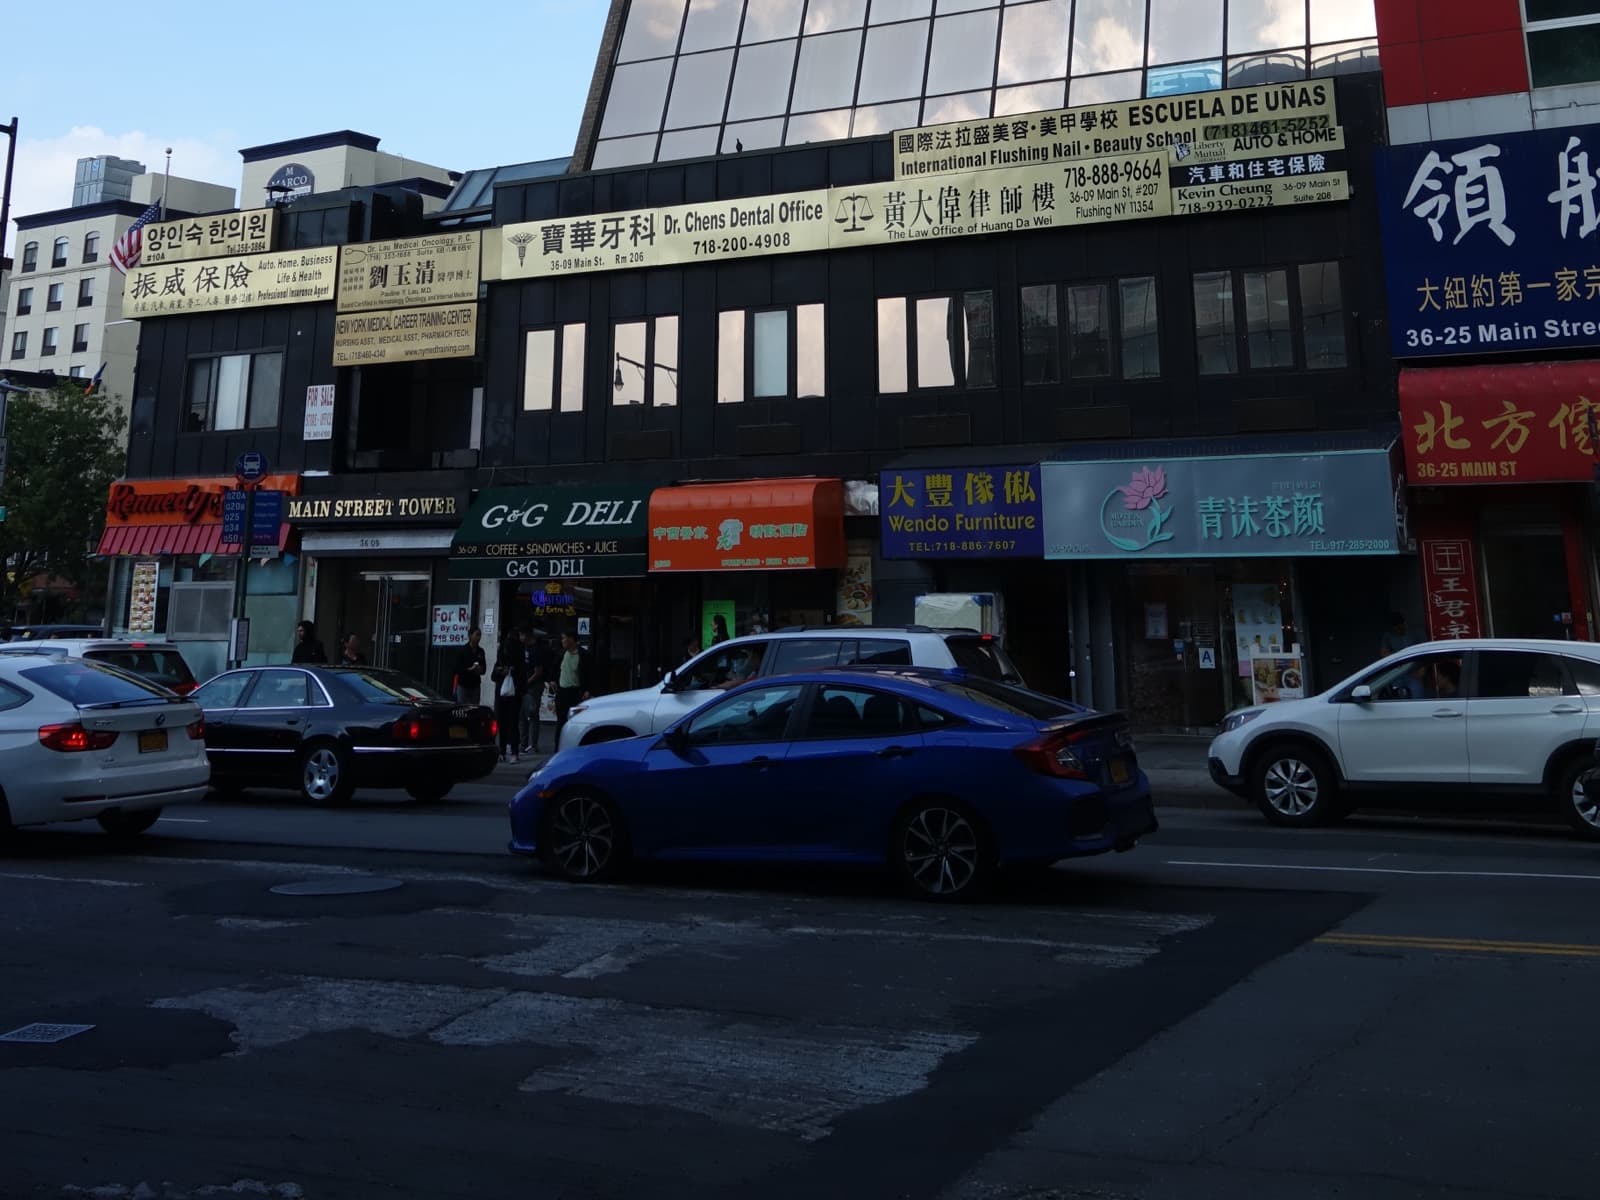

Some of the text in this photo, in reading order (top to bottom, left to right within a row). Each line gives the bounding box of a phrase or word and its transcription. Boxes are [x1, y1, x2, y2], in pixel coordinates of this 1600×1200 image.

[1129, 85, 1326, 127] ESCUELA DE UÑAS
[1194, 141, 1225, 150] Liberty
[1233, 128, 1337, 151] AUTO & HOME
[901, 128, 1196, 176] International Flushing Nail Beauty School
[1194, 148, 1226, 158] Mutual
[1063, 157, 1162, 189] 718-888-9664
[1188, 154, 1326, 184] 汽車和住宅保險
[1069, 189, 1095, 203] 36-09
[1097, 188, 1120, 201] Main
[1135, 183, 1159, 195] #207
[1177, 182, 1273, 200] Kevin Cheung
[1282, 181, 1307, 191] 36-09
[1309, 179, 1331, 189] Main
[883, 181, 1056, 230] 黃大偉律師樓
[1179, 196, 1274, 214] 718-939-0222
[1293, 193, 1314, 202] Suite
[664, 200, 823, 235] Dr. Chens Dental Office
[1075, 200, 1154, 219] Flushing NY 11354
[148, 214, 267, 251] 양인숙 한의원
[541, 213, 656, 256] 寶華牙科
[888, 215, 1052, 240] The Law Office of Huang Da Wei
[393, 240, 419, 249] Medical
[693, 232, 790, 255] 718-200-4908
[301, 255, 333, 266] Business
[550, 259, 572, 271] 36-09
[573, 257, 592, 269] Main
[615, 254, 627, 265] Rm
[630, 252, 644, 263] 206
[131, 262, 253, 299] 振威保險
[277, 269, 322, 283] Life & Health
[369, 260, 436, 289] 劉玉清
[258, 288, 288, 300] Professional
[313, 285, 329, 298] Agent
[336, 308, 472, 335] NEW YORK MEDICAL CAREER TRAINING CENTER
[335, 338, 361, 347] NURSING
[378, 334, 402, 344] MEDICAL
[1406, 319, 1600, 348] 36-25 Main Stre
[1417, 461, 1518, 478] 36-25 MAIN ST
[886, 470, 1036, 508] 大豐傢俬
[288, 496, 456, 518] MAIN STREET TOWER
[481, 500, 642, 529] G&G DELI
[888, 511, 1036, 533] Wendo Furniture
[485, 544, 519, 555] COFFEE
[526, 542, 585, 555] SANDWICHES
[593, 541, 618, 553] JUICE
[506, 559, 585, 577] G&G DELI
[434, 607, 468, 622] For R
[580, 620, 587, 631] A
[1202, 651, 1212, 663] A
